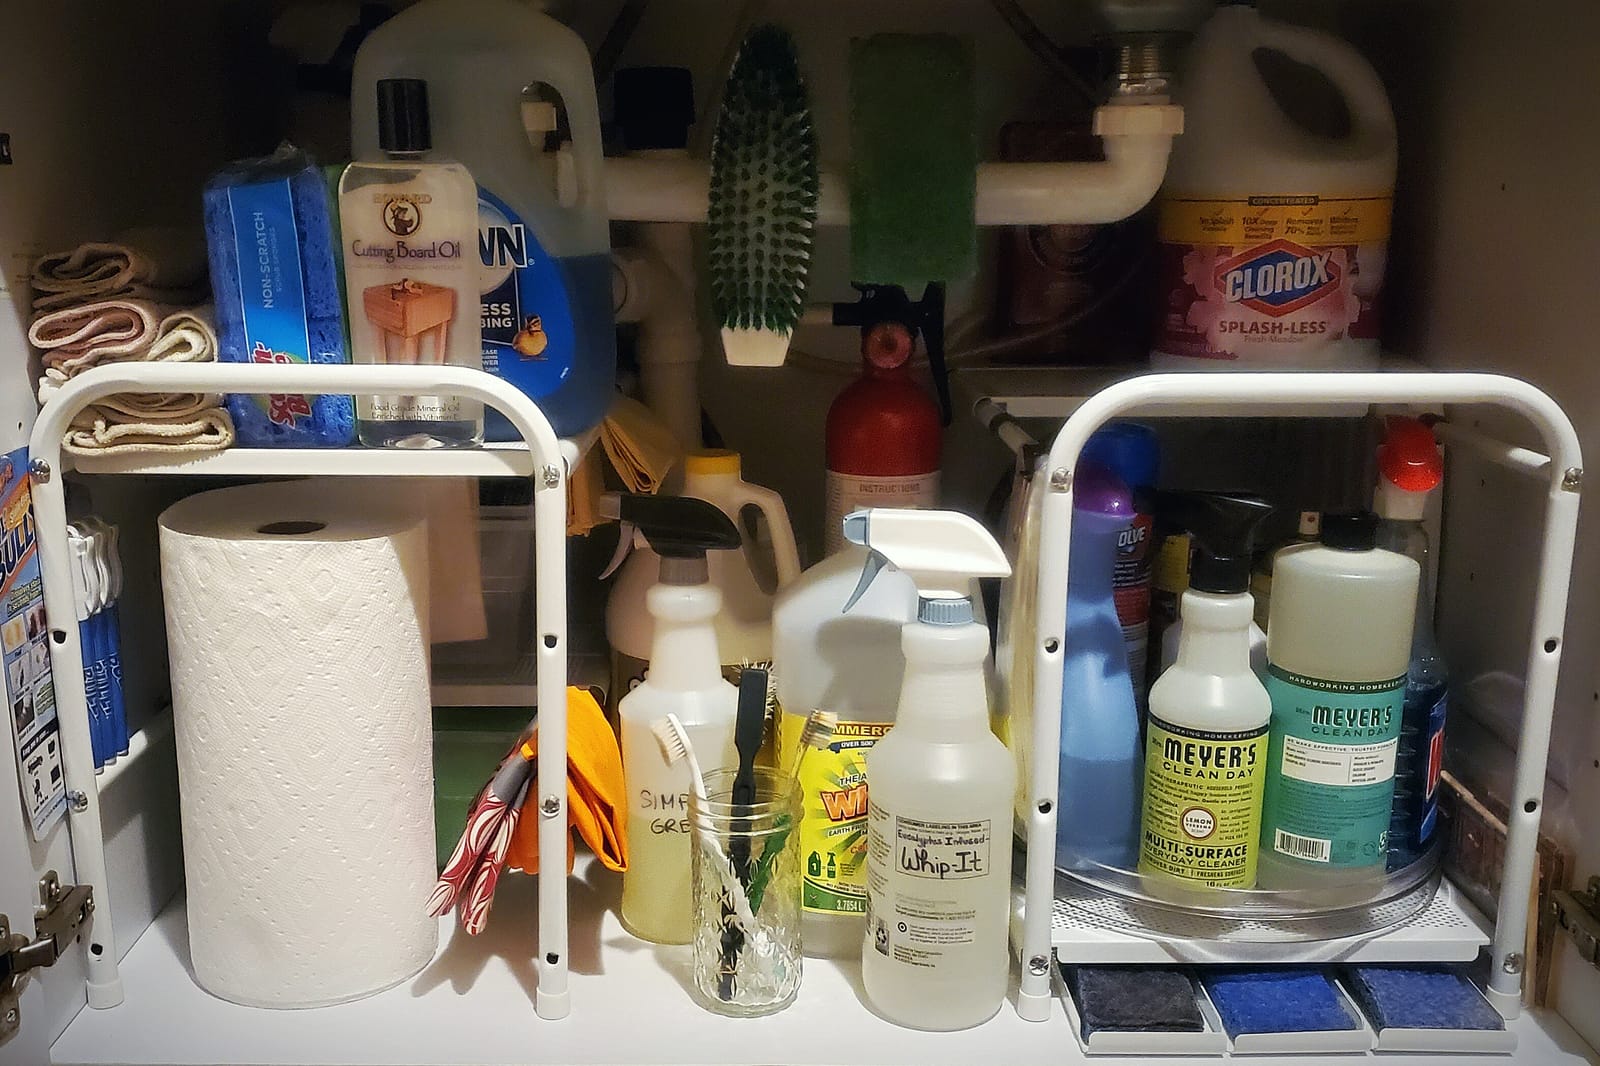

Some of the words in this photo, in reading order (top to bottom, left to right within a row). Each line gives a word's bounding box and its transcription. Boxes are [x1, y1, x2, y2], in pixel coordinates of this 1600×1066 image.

[352, 239, 395, 263] Cutting
[397, 241, 436, 258] Board
[439, 241, 461, 258] Oil
[479, 224, 526, 268] WN
[253, 211, 274, 309] NON-SCRATCH
[1226, 251, 1332, 303] CLOROX
[481, 303, 511, 315] ESS
[1219, 320, 1327, 334] SPLASH-LESS
[417, 402, 446, 411] Mineral
[1118, 526, 1146, 547] OLVE
[1289, 675, 1355, 691] HARDWORKING
[1312, 705, 1392, 728] MEYER'S
[1312, 726, 1362, 736] CLEAN
[1368, 726, 1390, 736] DAY
[1164, 738, 1257, 768] MEYER'S
[840, 775, 858, 785] THE
[1163, 761, 1219, 779] CLEAN
[1226, 768, 1255, 779] DAY
[641, 790, 688, 811] SIMP
[651, 818, 690, 834] GRE
[1185, 817, 1212, 825] LEMON
[1144, 842, 1194, 865] EVERYDAY
[1198, 857, 1246, 868] CLEANER
[1145, 830, 1247, 859] MULTI-SURFACE
[901, 846, 982, 879] Whip-It
[1169, 865, 1185, 874] DIRT
[1196, 870, 1223, 878] FRESHENS
